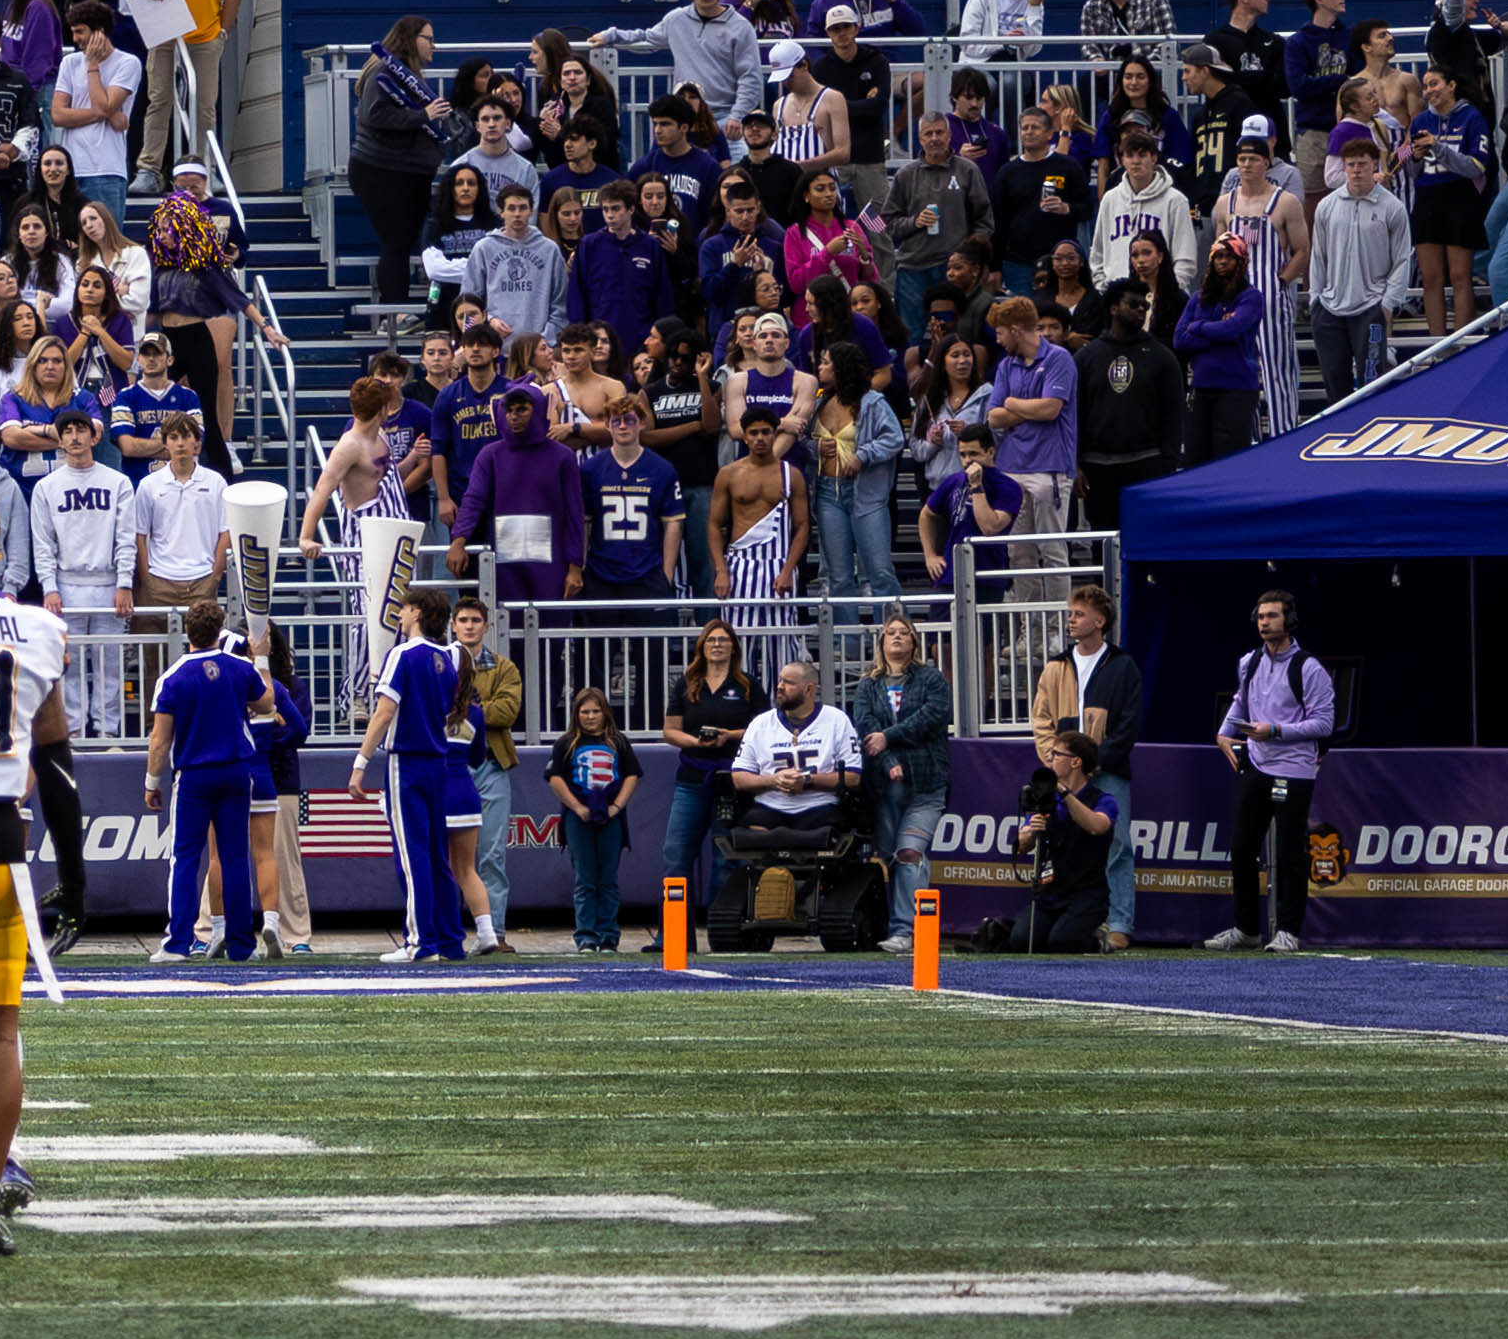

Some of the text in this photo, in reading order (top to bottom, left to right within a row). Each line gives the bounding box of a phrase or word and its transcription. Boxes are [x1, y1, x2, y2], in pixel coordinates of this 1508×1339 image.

[1196, 130, 1224, 177] 24
[948, 176, 959, 189] A
[1111, 214, 1161, 240] JMU
[502, 281, 532, 292] DUKES
[653, 395, 701, 411] JMU
[462, 423, 497, 439] DUKES
[57, 488, 111, 514] JMU
[603, 496, 648, 540] 25
[238, 533, 270, 619] JMU
[378, 536, 415, 636] JMU
[773, 750, 819, 772] 25
[943, 867, 991, 880] OFFICIAL
[1141, 874, 1233, 888] OF JMU ATHLET
[1367, 879, 1421, 893] OFFICIAL
[1424, 879, 1474, 893] GARAGE
